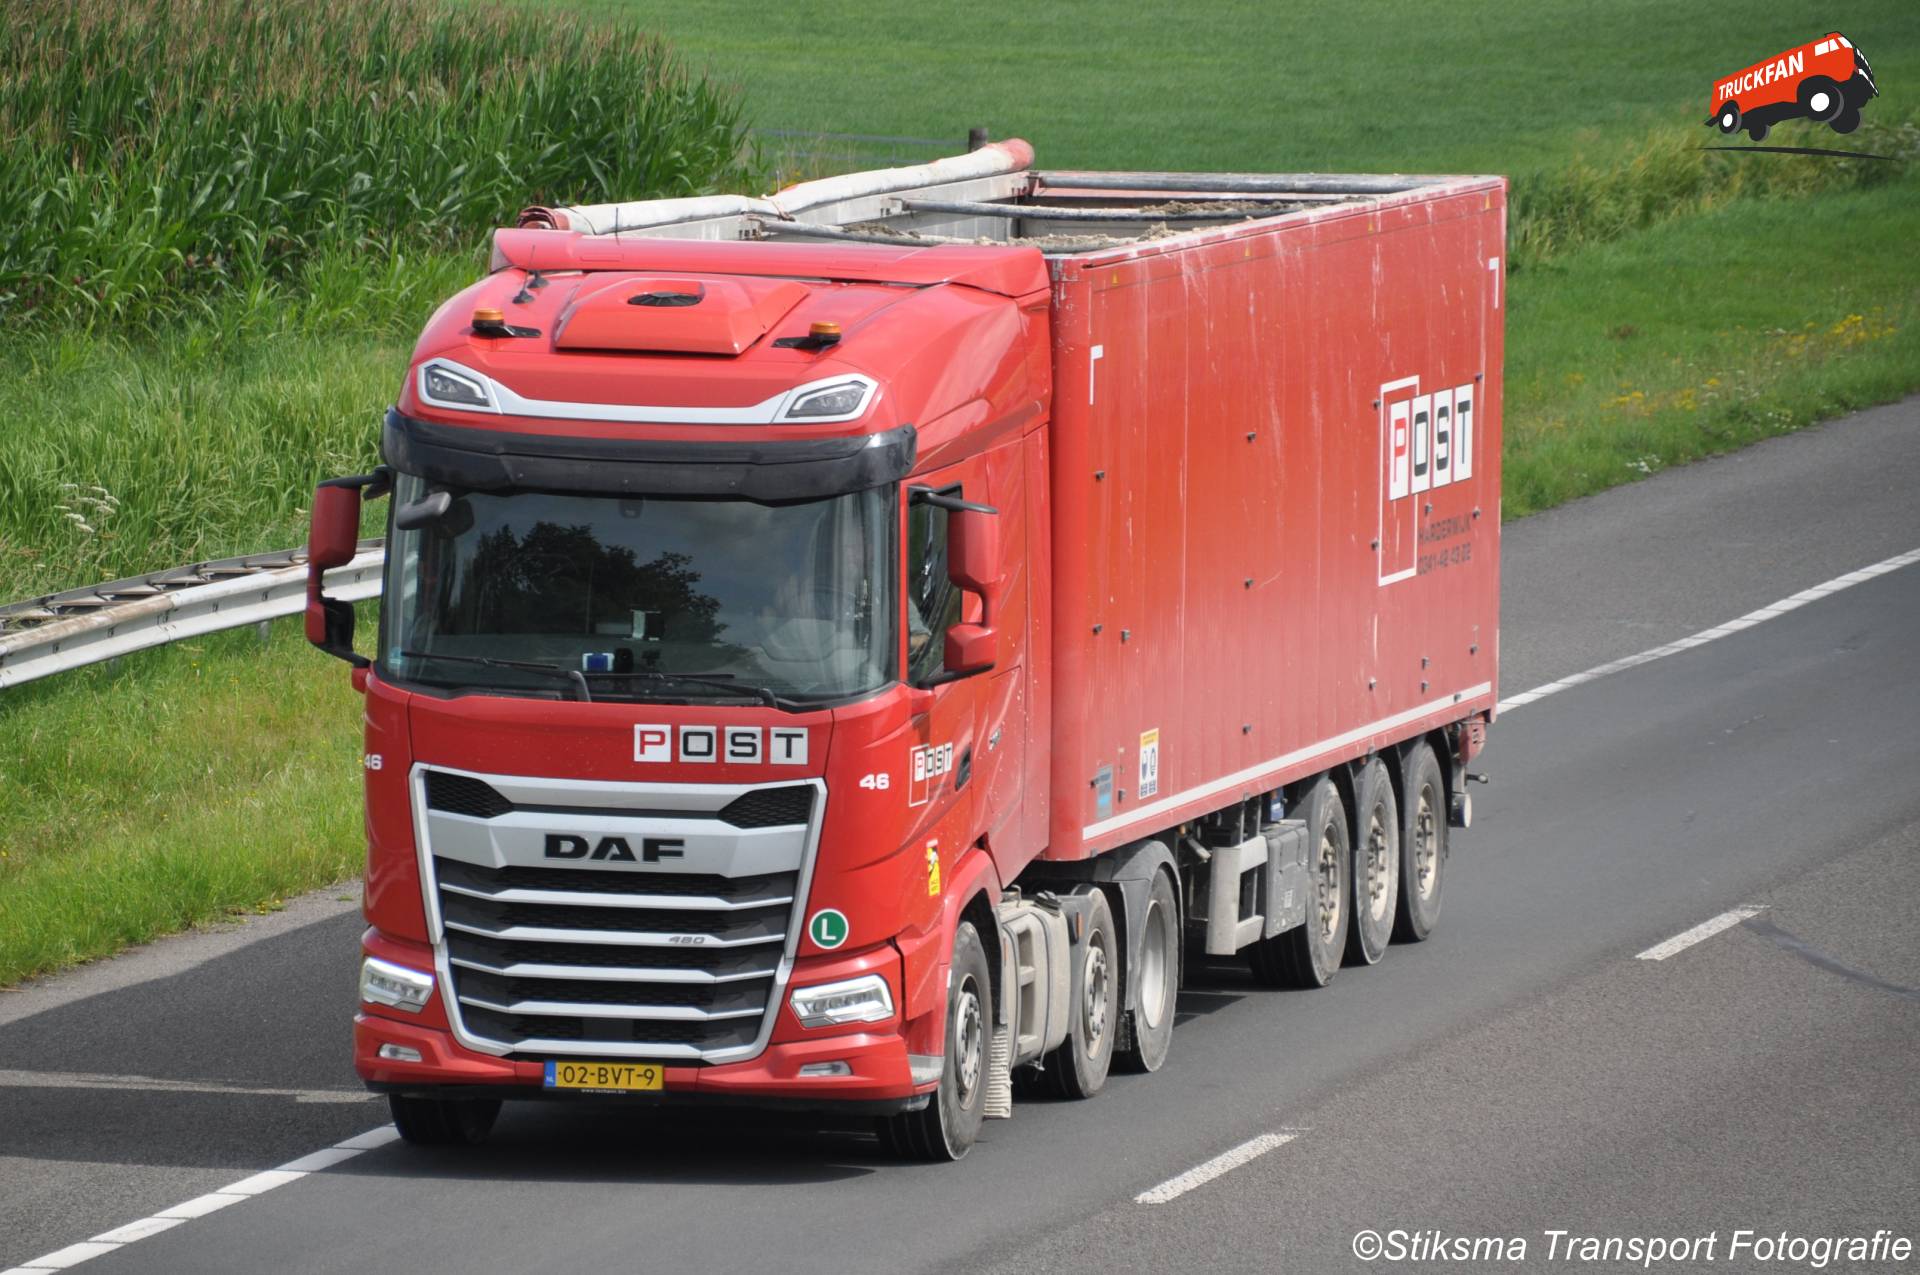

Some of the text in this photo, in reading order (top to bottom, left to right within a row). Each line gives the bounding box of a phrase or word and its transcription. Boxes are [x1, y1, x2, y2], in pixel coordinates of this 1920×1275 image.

[1392, 398, 1471, 484] POST
[638, 729, 804, 759] POST
[364, 753, 382, 770] 46
[916, 745, 953, 777] POST
[859, 773, 890, 790] 46
[545, 833, 685, 862] DAF
[669, 935, 706, 945] 480
[821, 918, 837, 941] L
[562, 1065, 656, 1086] 02-BVT-9
